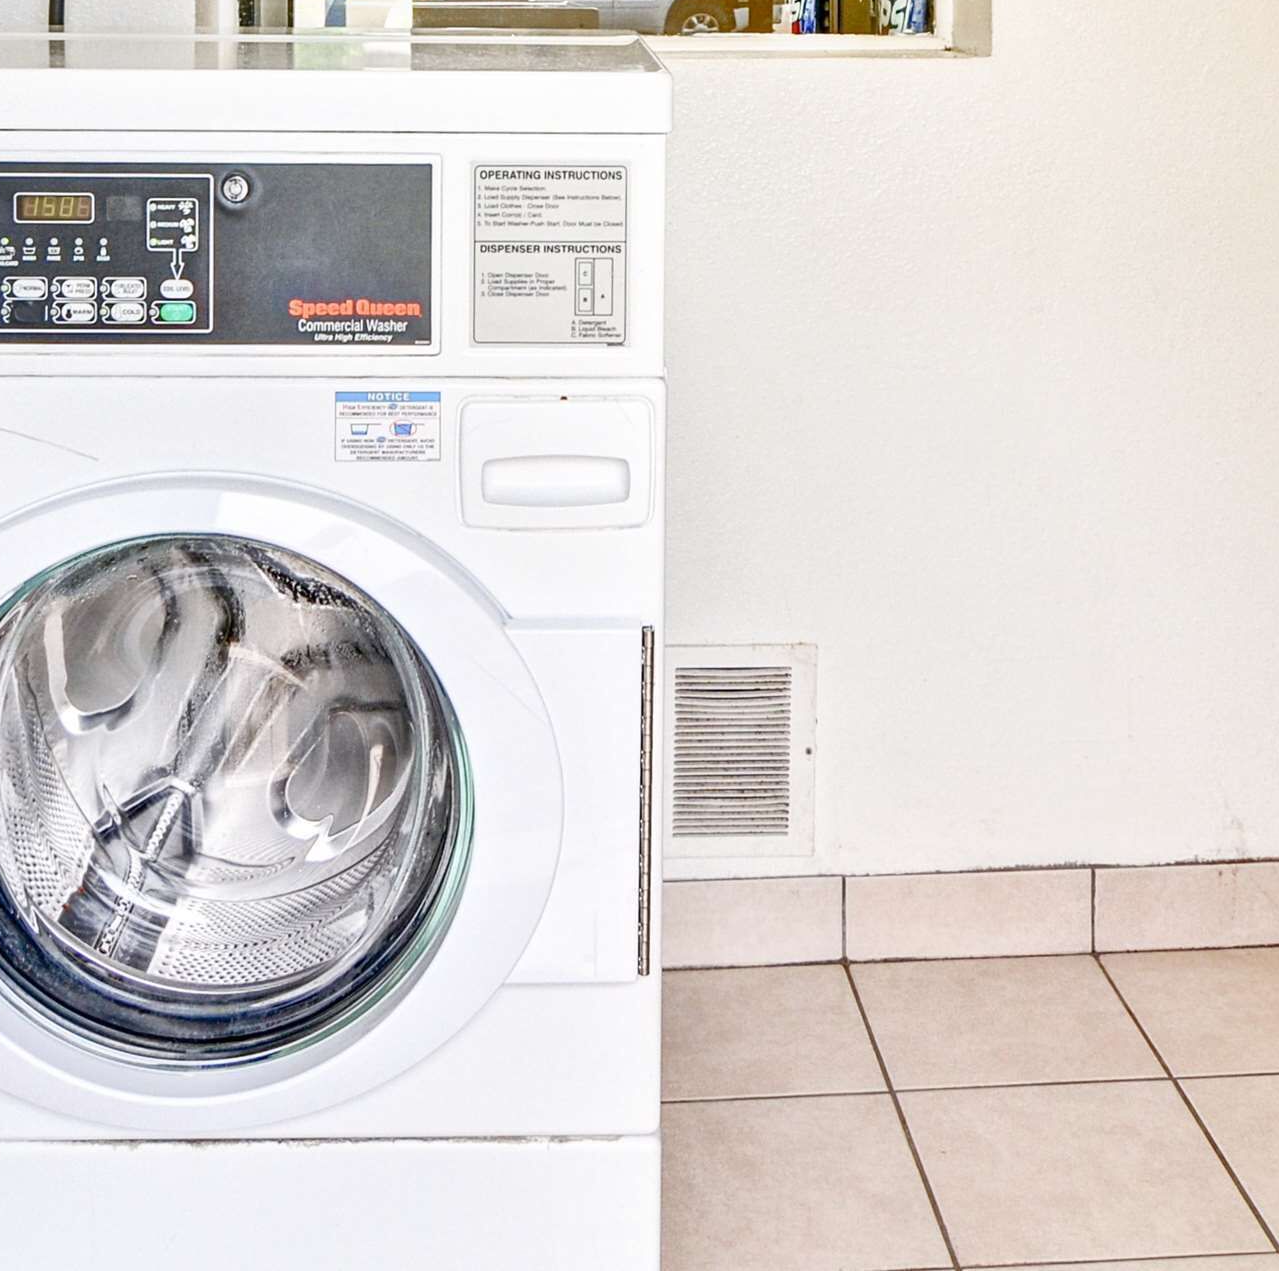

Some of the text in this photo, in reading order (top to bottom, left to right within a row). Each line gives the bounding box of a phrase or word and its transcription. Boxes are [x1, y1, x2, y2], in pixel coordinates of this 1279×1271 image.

[480, 170, 623, 180] OPERATING INSTRUCTIONS
[480, 245, 622, 254] DISPENSER INSTRUCTIONS
[288, 299, 420, 318] Speed Queen
[298, 319, 408, 332] Commercial Washer
[335, 334, 353, 343] High
[354, 334, 393, 343] Efficiency
[368, 392, 410, 401] NOTICE
